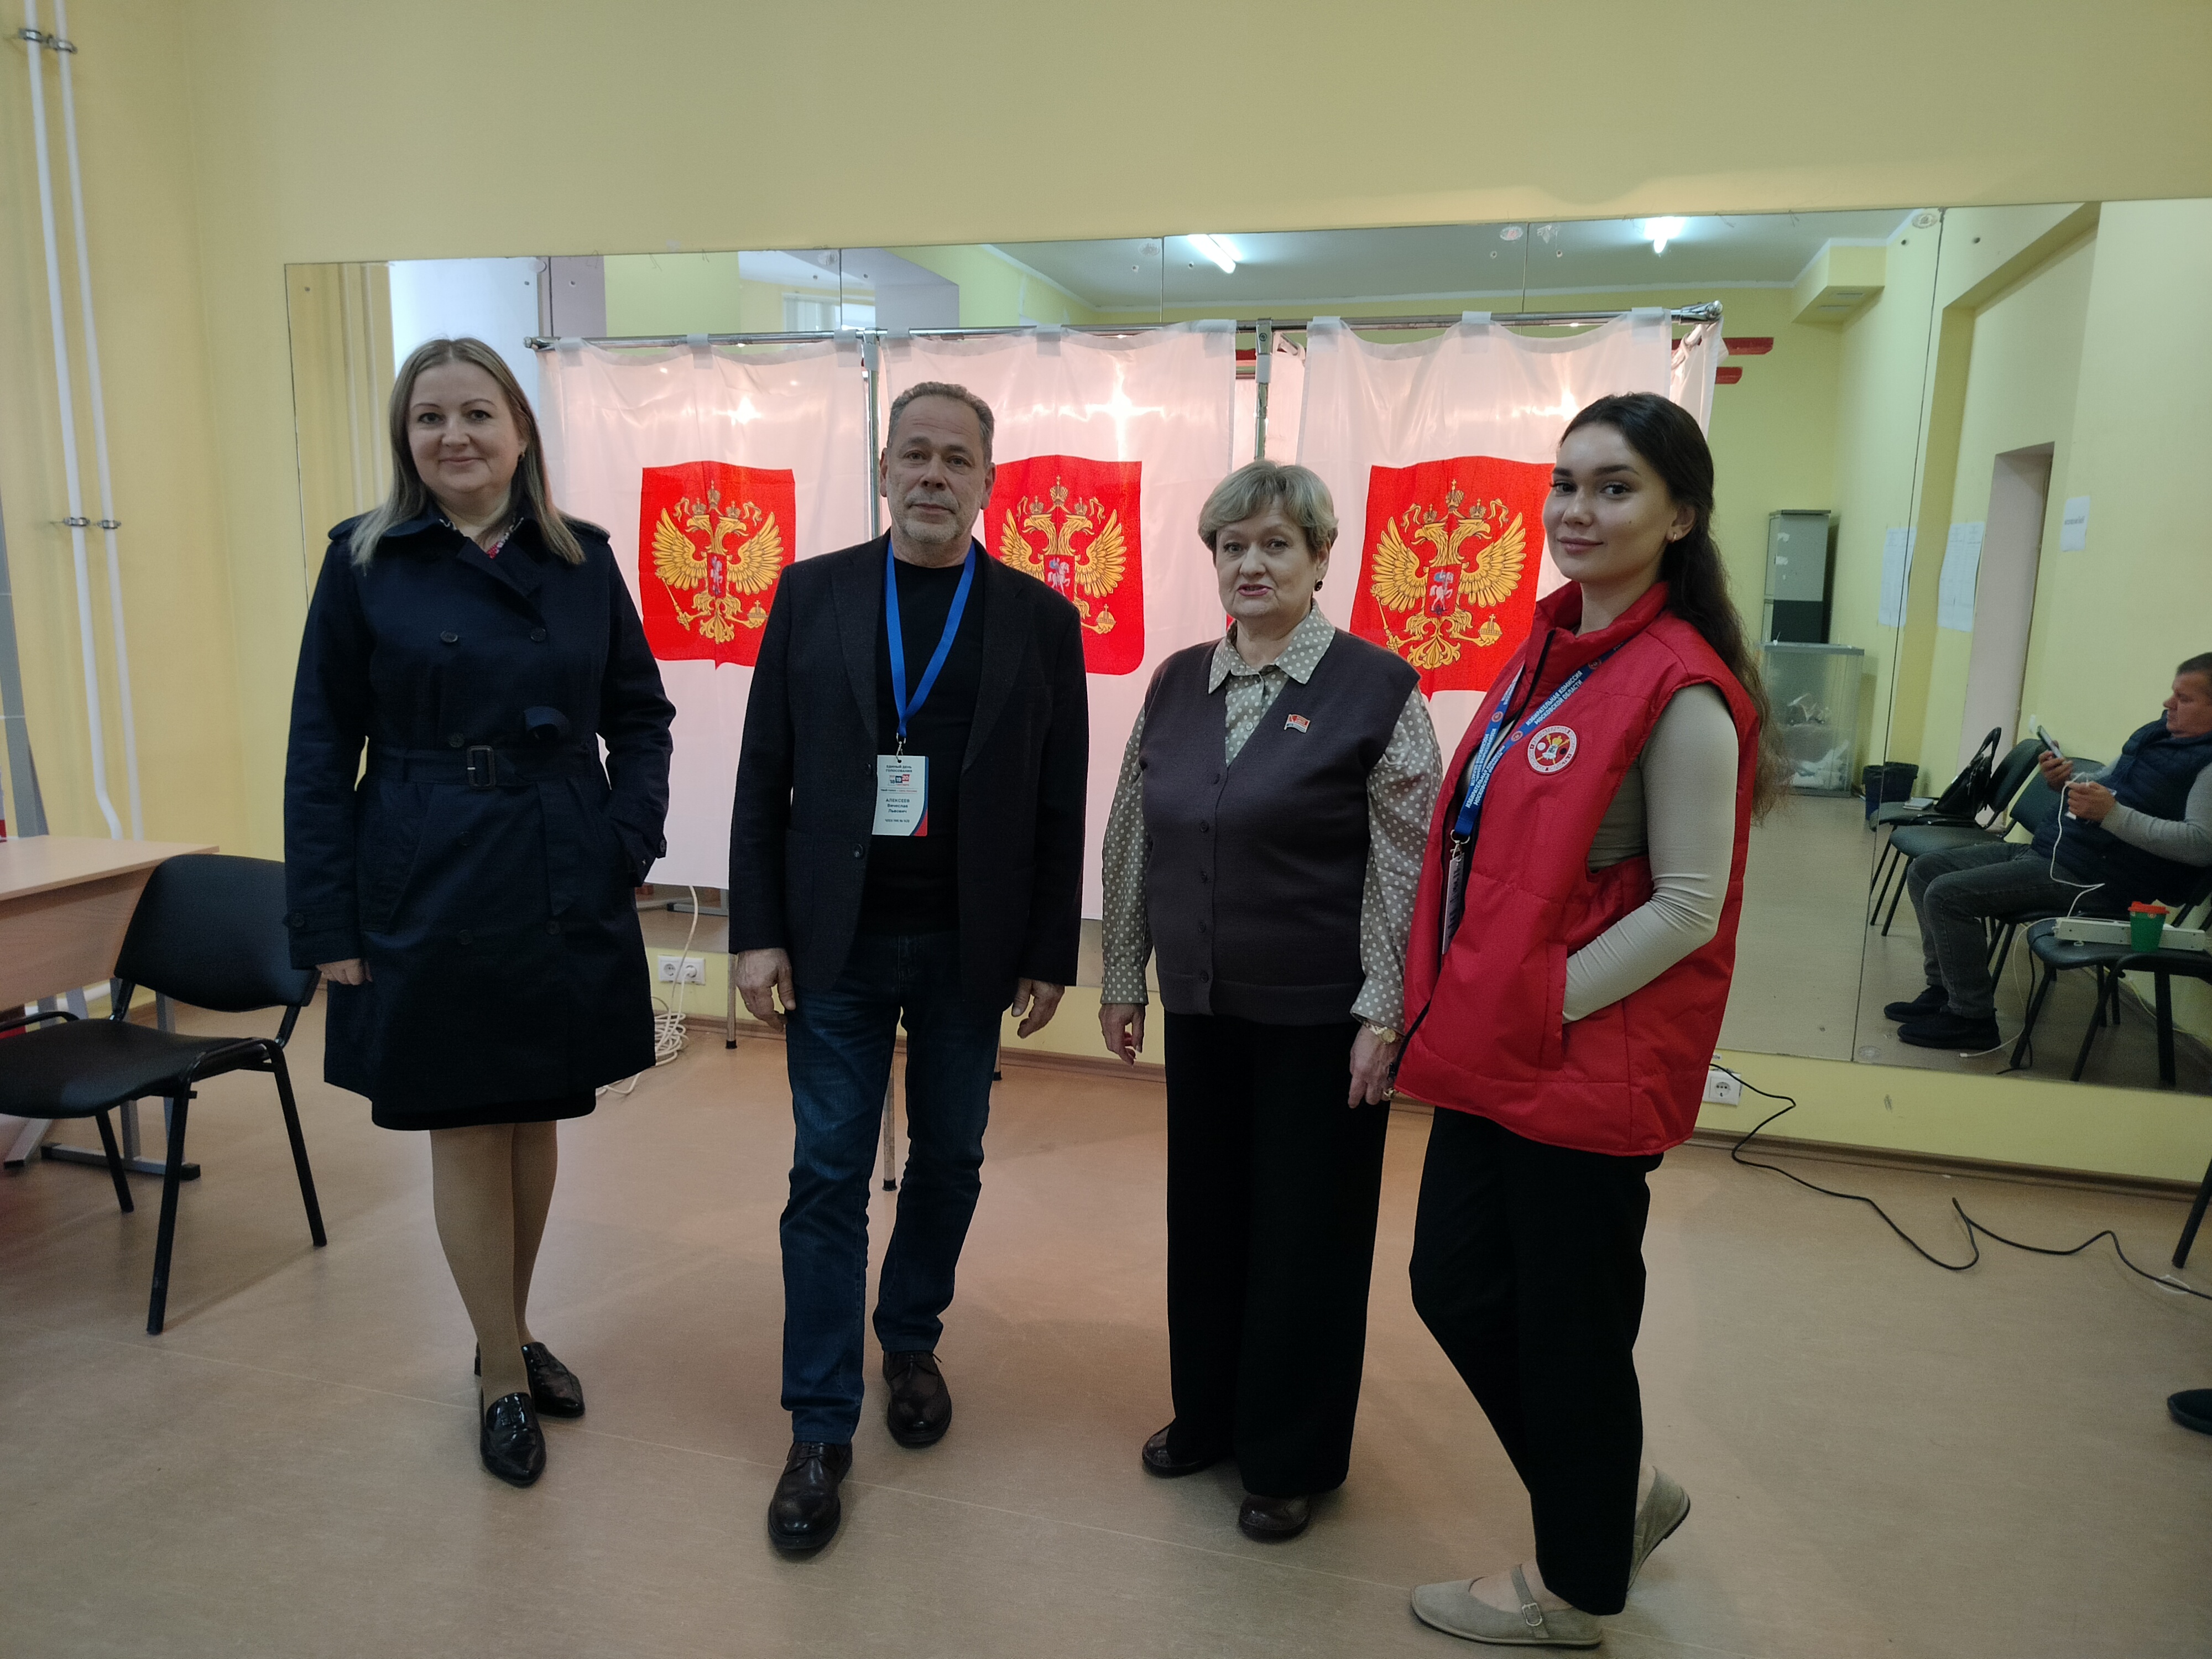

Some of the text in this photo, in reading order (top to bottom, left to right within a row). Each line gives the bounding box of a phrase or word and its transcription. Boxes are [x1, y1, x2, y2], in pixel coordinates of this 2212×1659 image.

[1526, 692, 1561, 726] ИЗБИРАТЕЛЬНАЯ
[1558, 670, 1583, 695] КОМИССИЯ
[1534, 680, 1583, 724] МОСКОВСКОЙ ОБЛАСТИ
[1465, 769, 1488, 808] ИЗБИРАТЕЛЬНАЯ
[1473, 773, 1490, 805] МОСКОВСКОЙ
